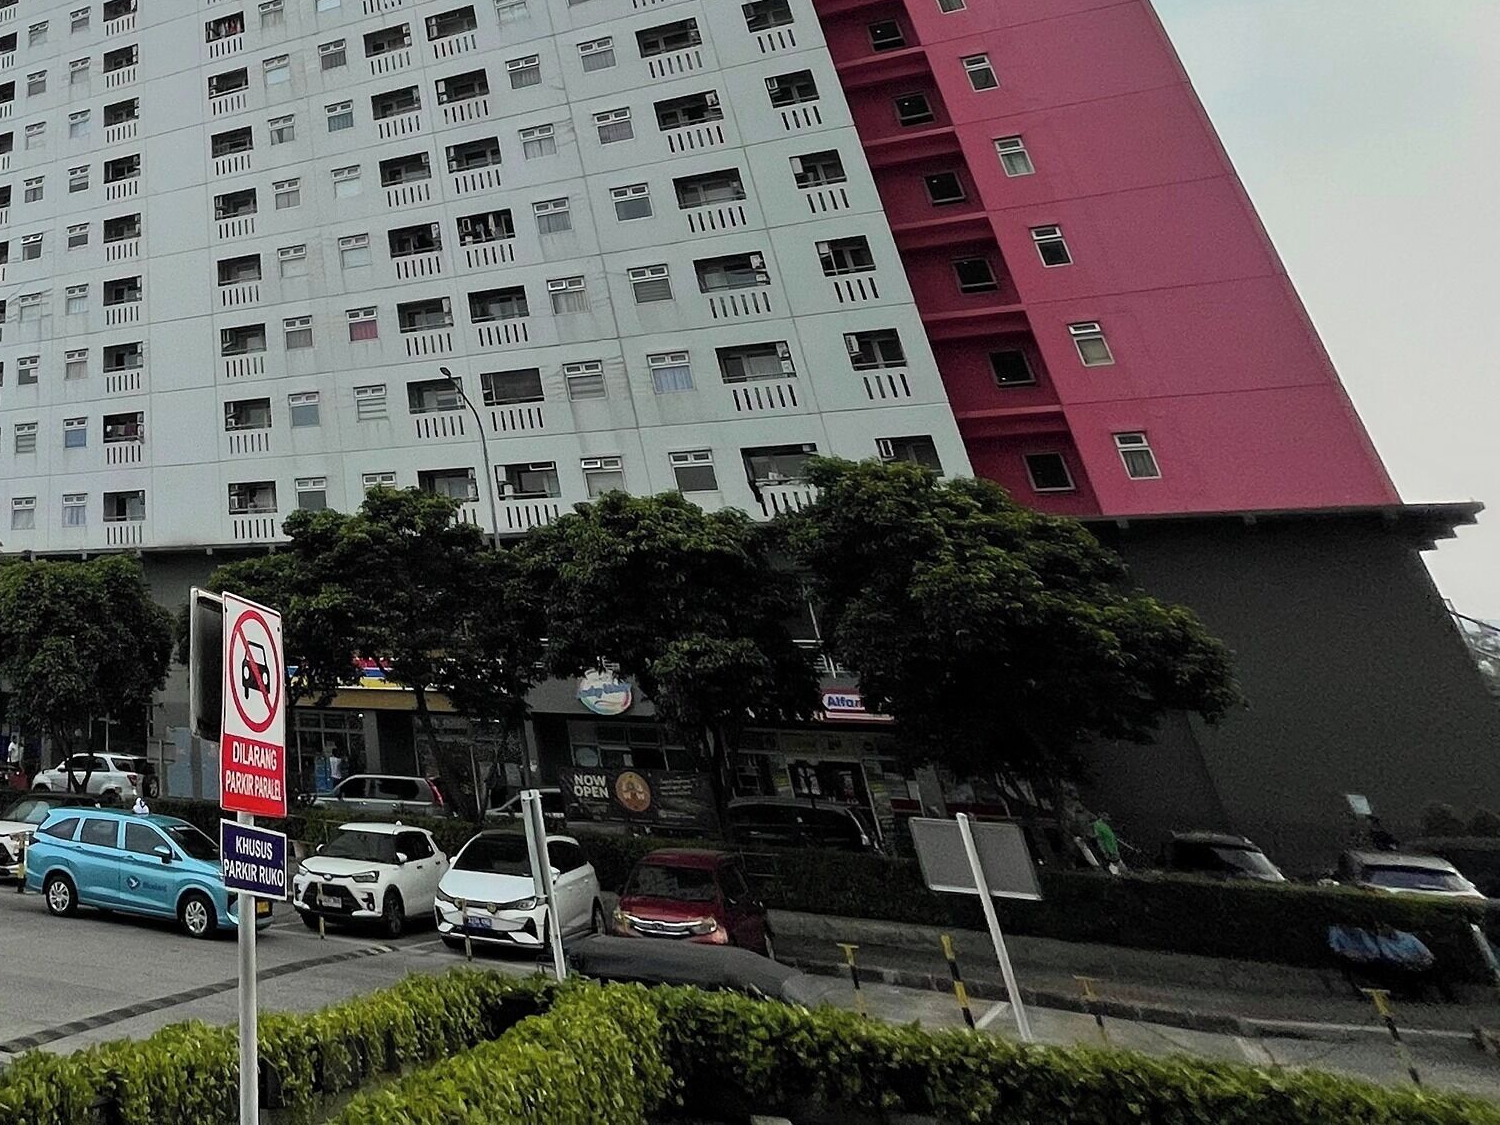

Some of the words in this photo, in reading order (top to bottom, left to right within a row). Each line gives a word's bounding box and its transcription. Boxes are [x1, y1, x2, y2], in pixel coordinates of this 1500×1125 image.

[232, 741, 277, 771] DILARANG
[225, 770, 254, 796] PARKIR
[254, 775, 281, 801] PARALEL
[574, 774, 606, 787] NOW
[574, 786, 609, 799] OPEN
[235, 835, 273, 860] KHUSUS
[223, 858, 257, 882] PARKIR
[259, 865, 284, 887] RUKO
